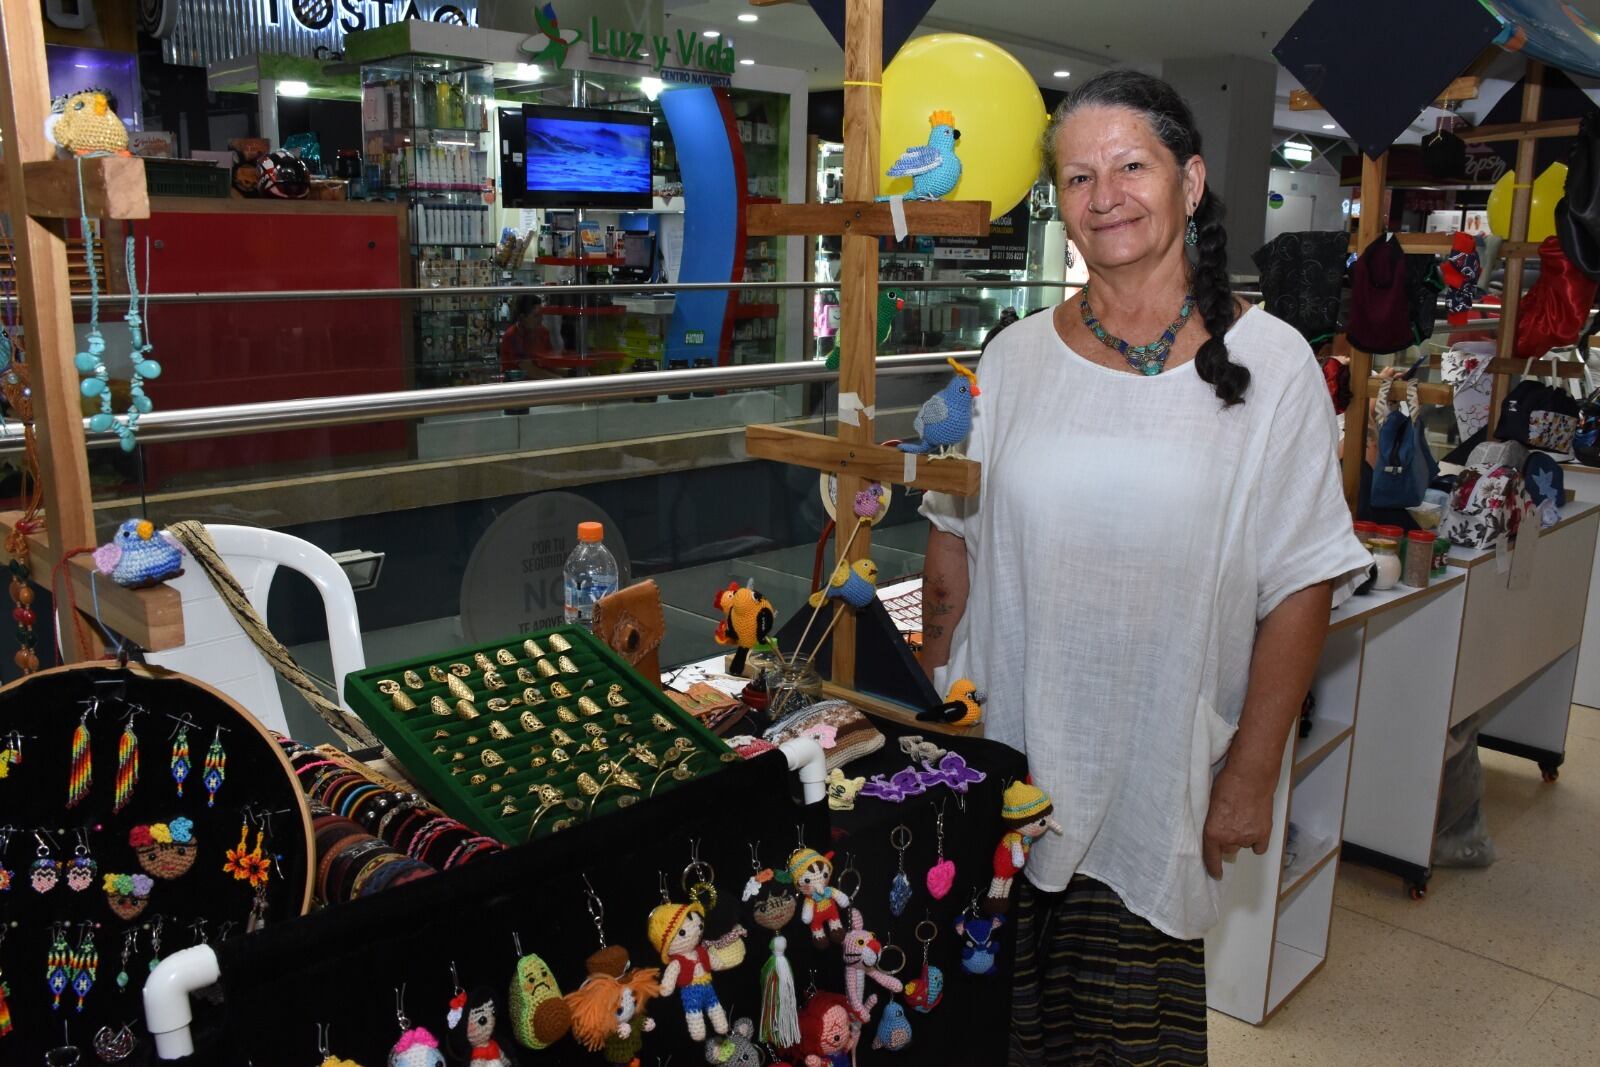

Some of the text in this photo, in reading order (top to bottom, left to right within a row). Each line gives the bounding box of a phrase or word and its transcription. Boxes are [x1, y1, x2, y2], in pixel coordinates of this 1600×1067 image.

[591, 16, 736, 74] Luz y Vida
[659, 69, 732, 87] CENTRO NATURISTA
[532, 537, 566, 556] POR TU
